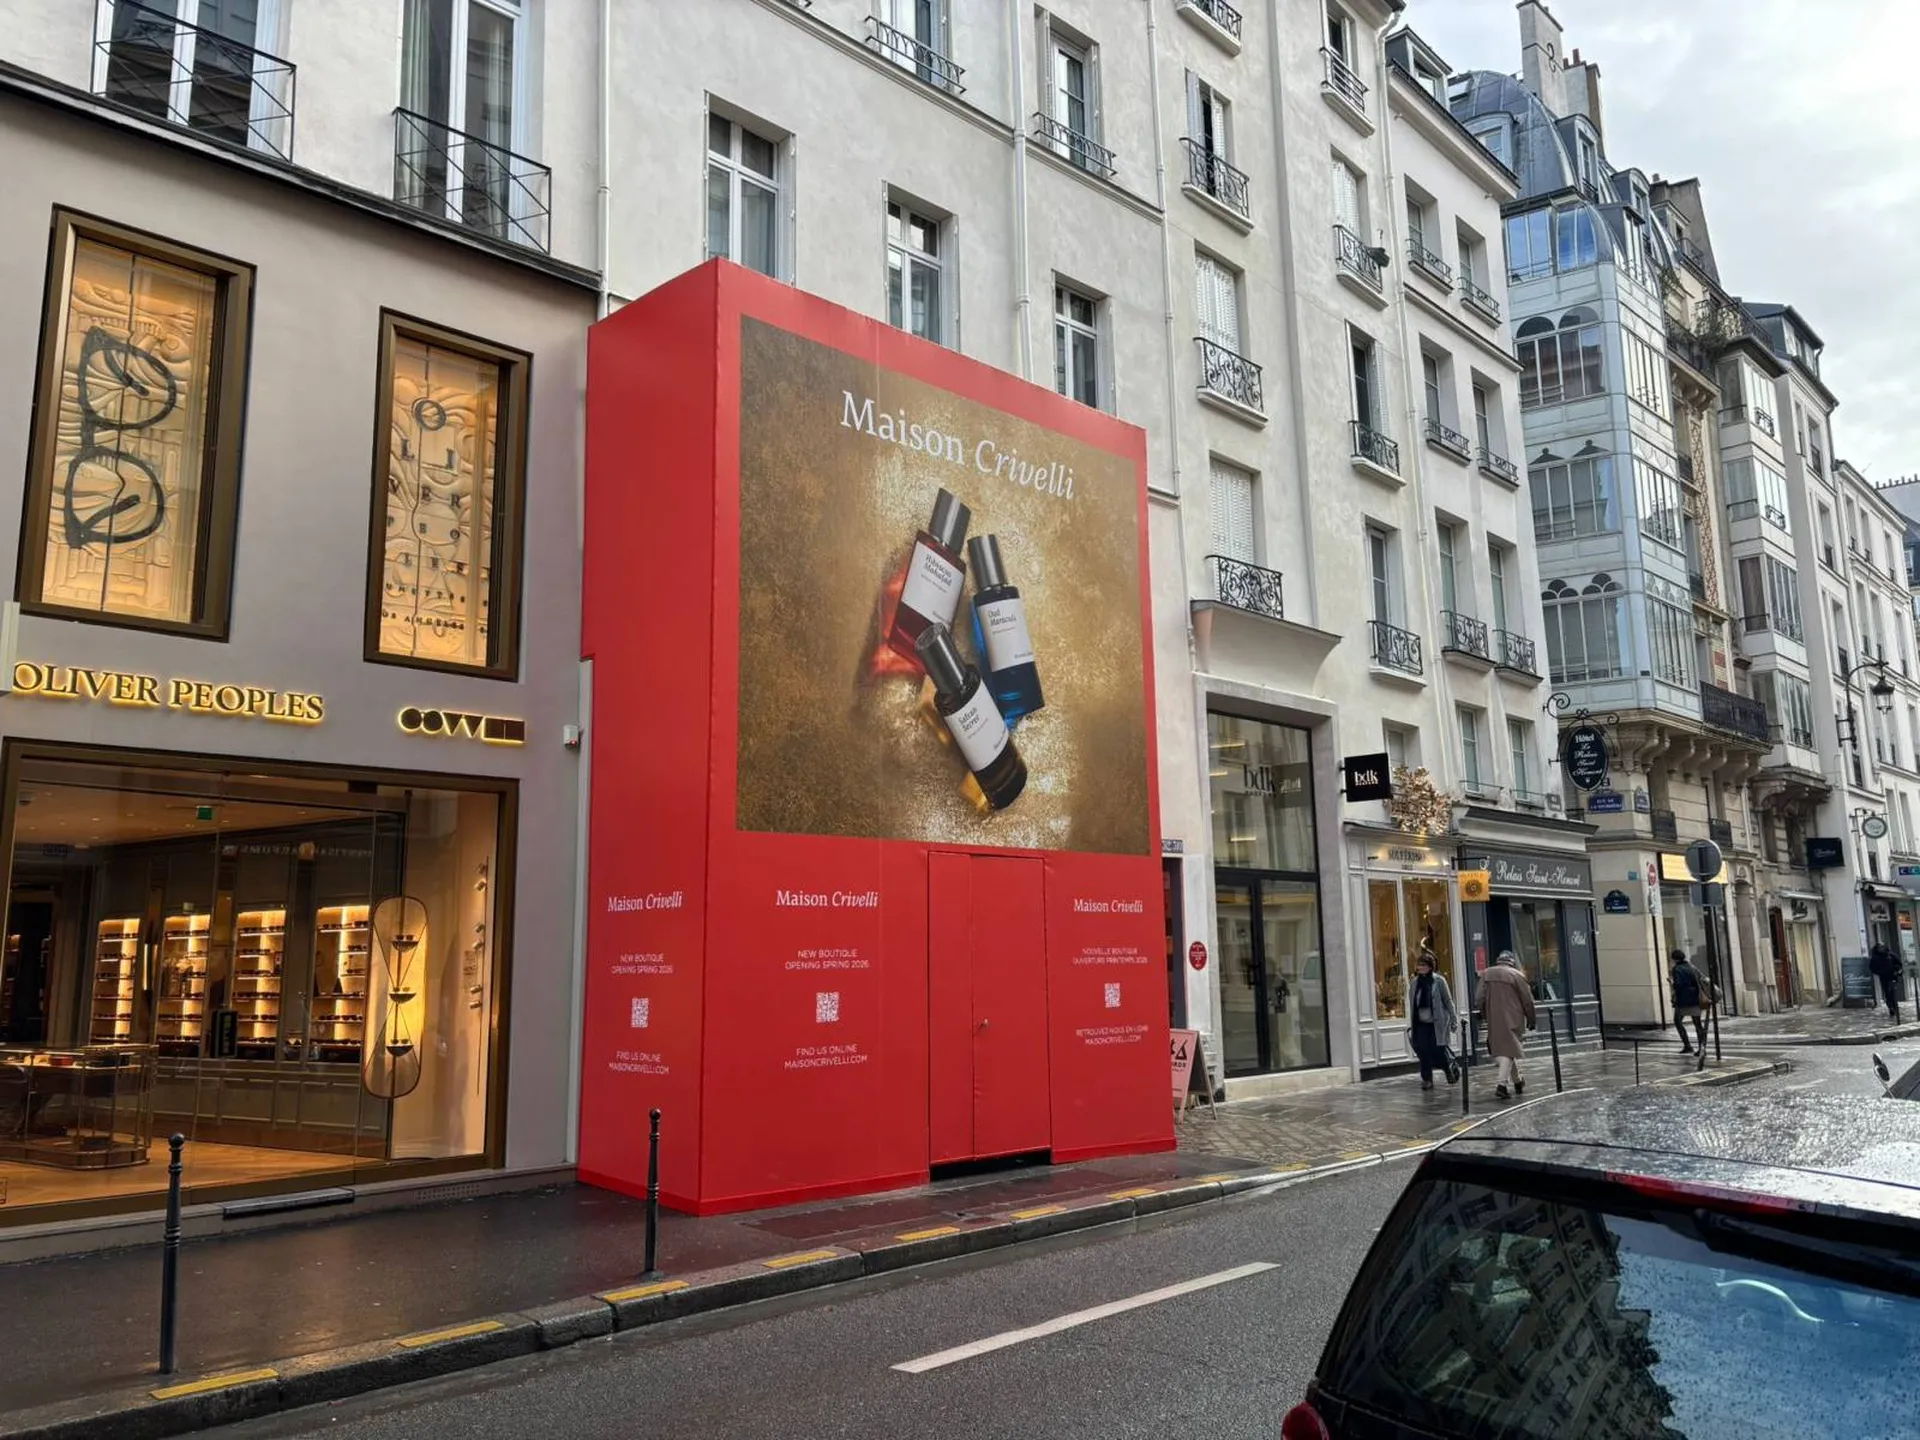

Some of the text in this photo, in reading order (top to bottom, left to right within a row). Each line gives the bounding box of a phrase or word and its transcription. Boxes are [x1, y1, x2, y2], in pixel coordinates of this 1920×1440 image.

[840, 390, 1074, 499] Maison Crivelli
[12, 661, 325, 722] OLIVER PEOPLES
[607, 890, 683, 912] Maison Crivelli
[775, 889, 879, 908] Maison Crivelli
[1073, 898, 1144, 913] Maison Crivelli
[797, 948, 859, 959] NEW BOUTIQUE
[785, 960, 821, 970] OPENING
[822, 960, 850, 969] SPRING
[796, 1043, 858, 1057] FIND US ONLINE
[784, 1055, 869, 1069] MAISONCRIVELLI.COM
